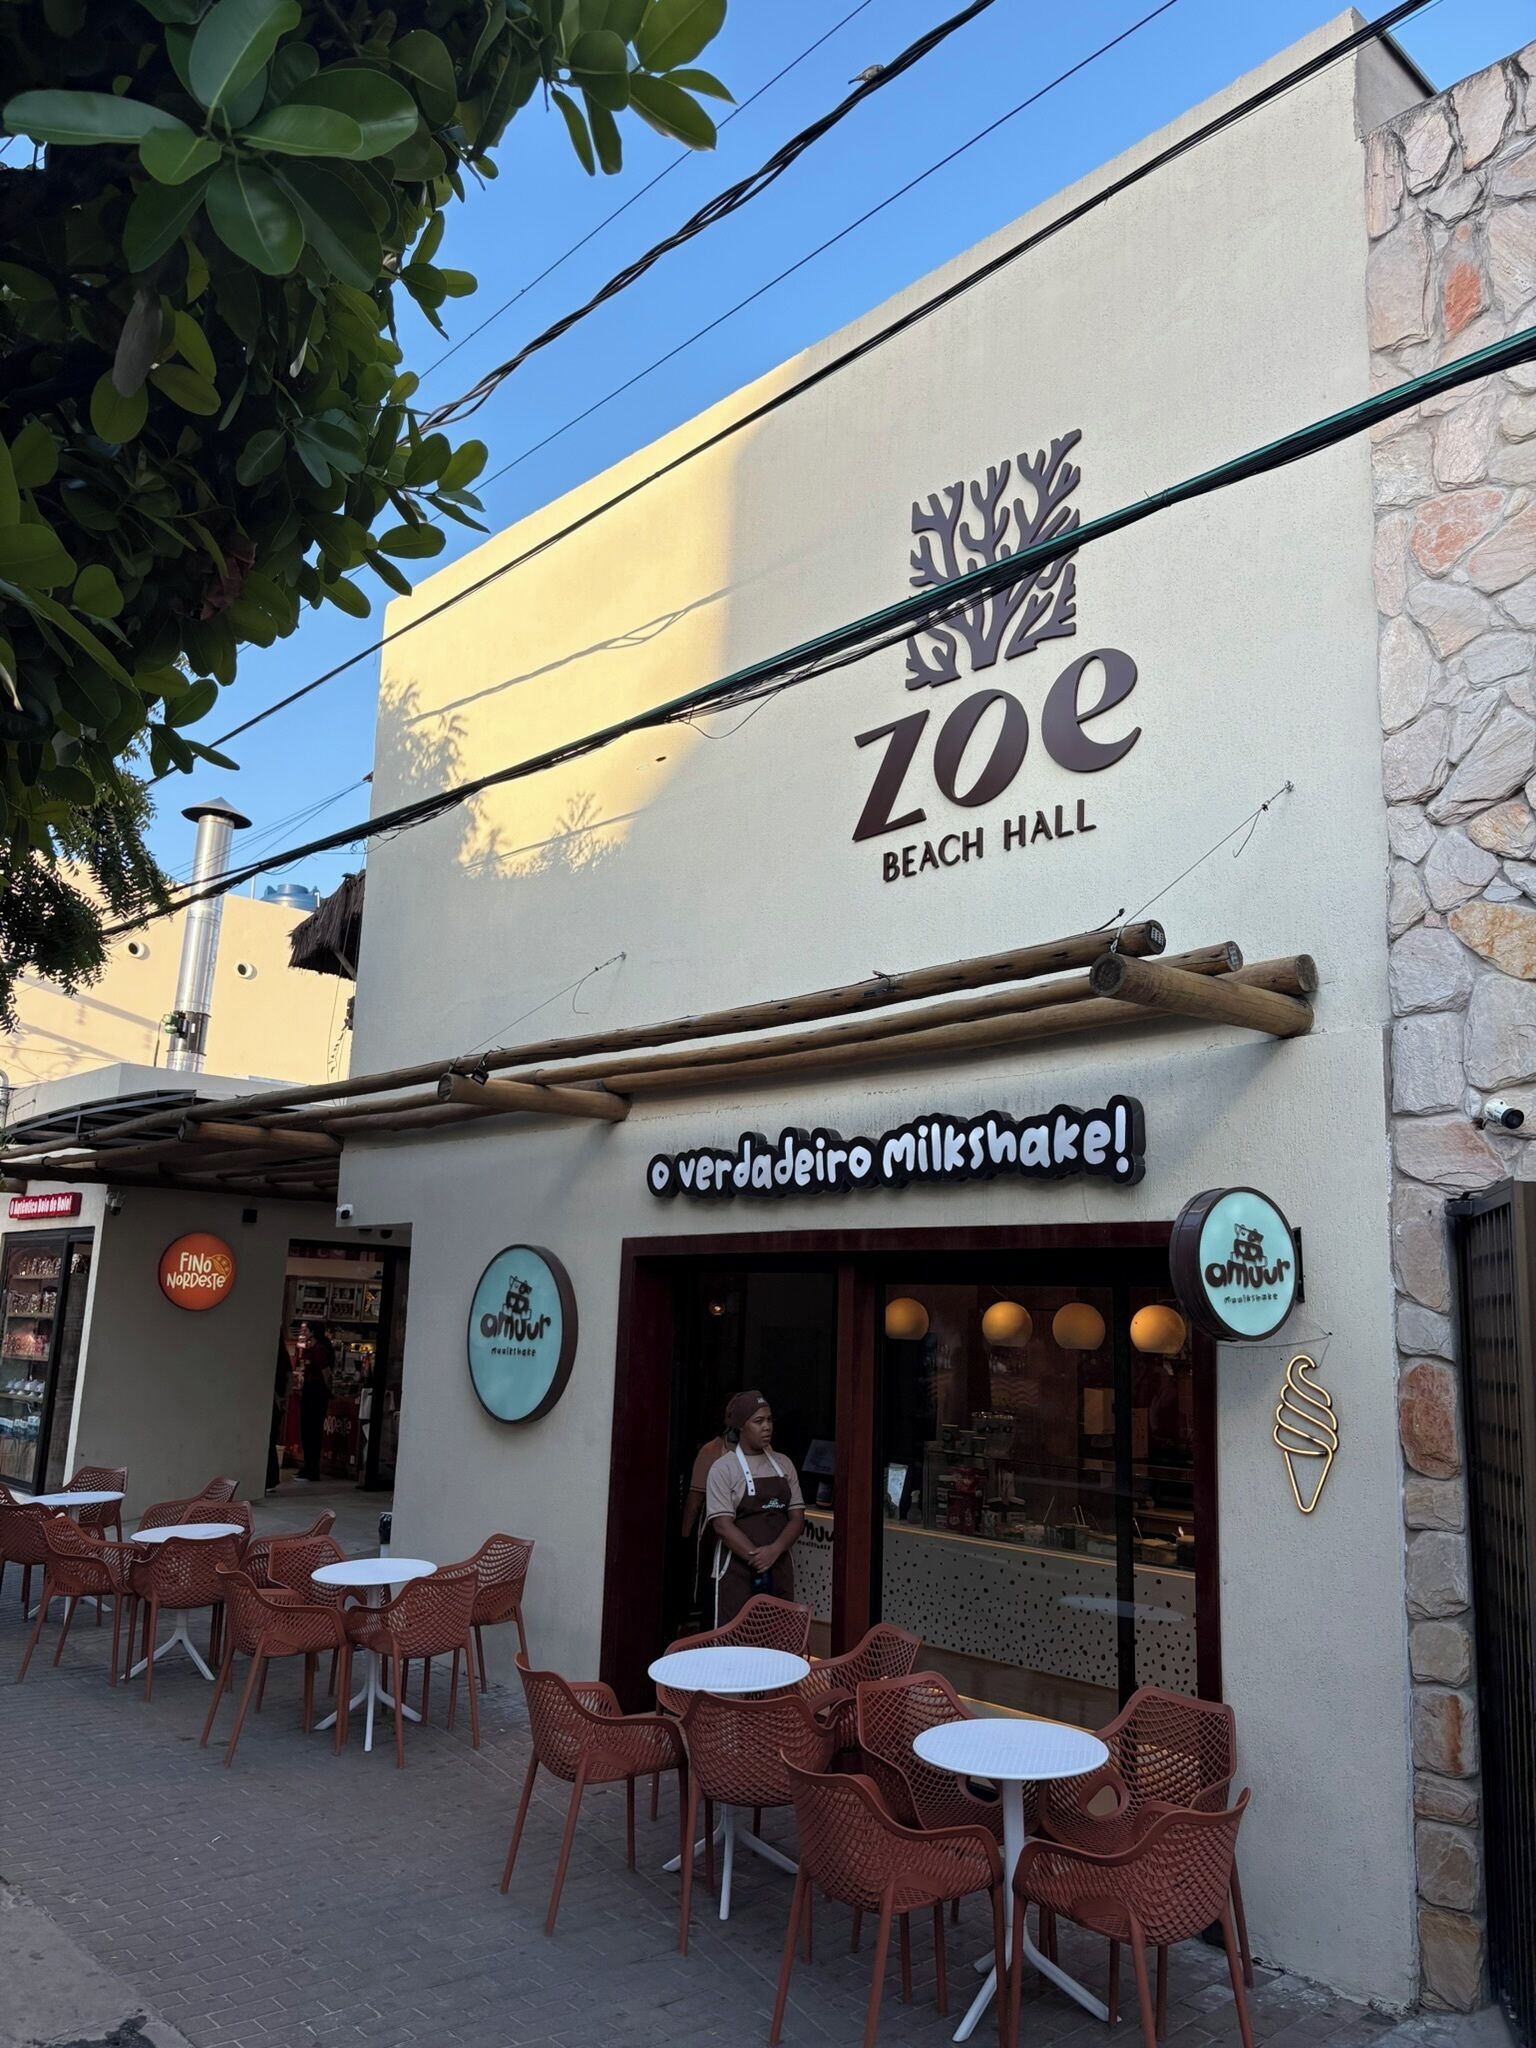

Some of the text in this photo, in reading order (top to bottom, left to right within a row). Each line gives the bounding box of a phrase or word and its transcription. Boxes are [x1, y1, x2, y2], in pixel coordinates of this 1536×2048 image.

[852, 648, 1142, 842] zoe
[882, 799, 1097, 883] BEACH HALL
[680, 1137, 876, 1191] verdadeiro
[883, 1104, 1130, 1178] milkshake!
[1206, 1258, 1290, 1288] amuur
[481, 1312, 551, 1341] amuur
